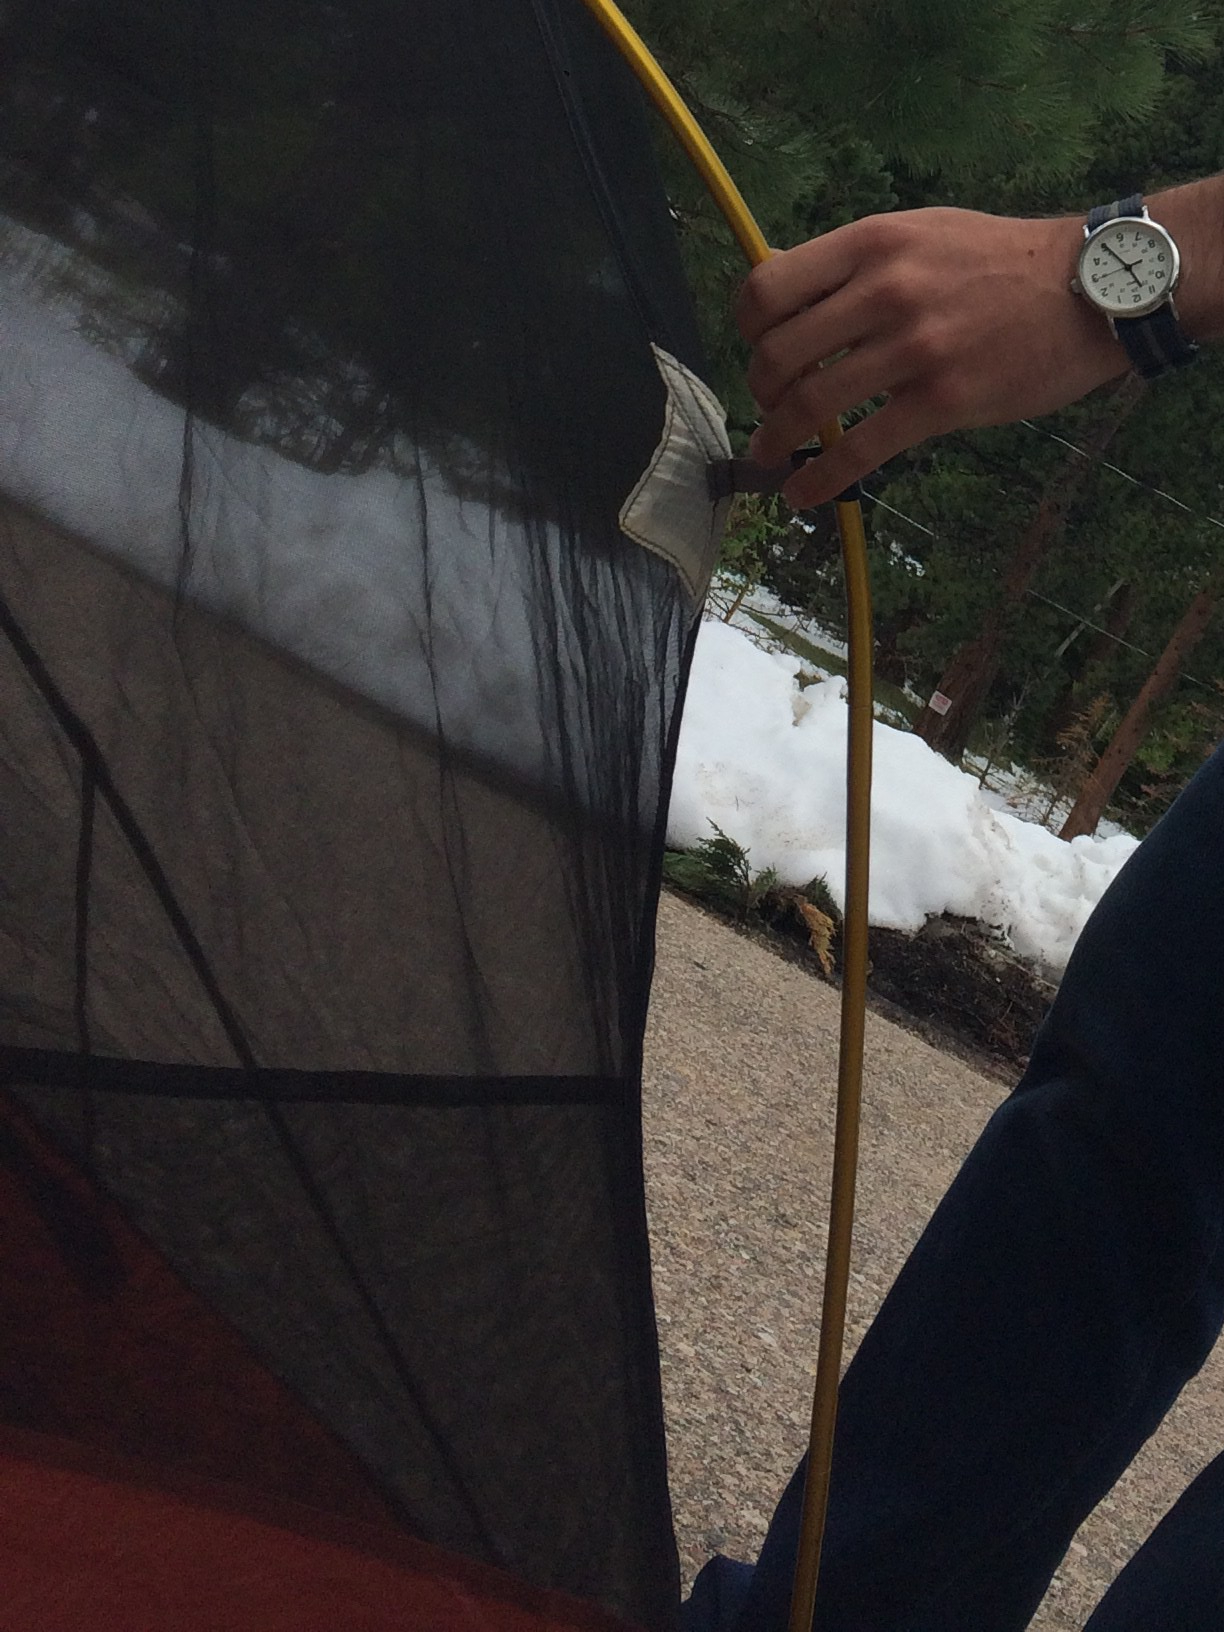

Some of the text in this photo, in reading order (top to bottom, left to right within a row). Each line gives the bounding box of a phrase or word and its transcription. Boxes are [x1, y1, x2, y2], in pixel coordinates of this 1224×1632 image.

[1116, 232, 1124, 242] 6
[1135, 232, 1142, 241] 7
[1148, 239, 1156, 248] 8
[1093, 257, 1100, 266] 4
[1157, 252, 1165, 262] 9
[1091, 273, 1099, 283] 3
[1155, 269, 1165, 279] 10
[1100, 287, 1109, 297] 2
[1149, 284, 1156, 294] 11
[1117, 295, 1121, 304] 1
[1132, 294, 1142, 303] 12
